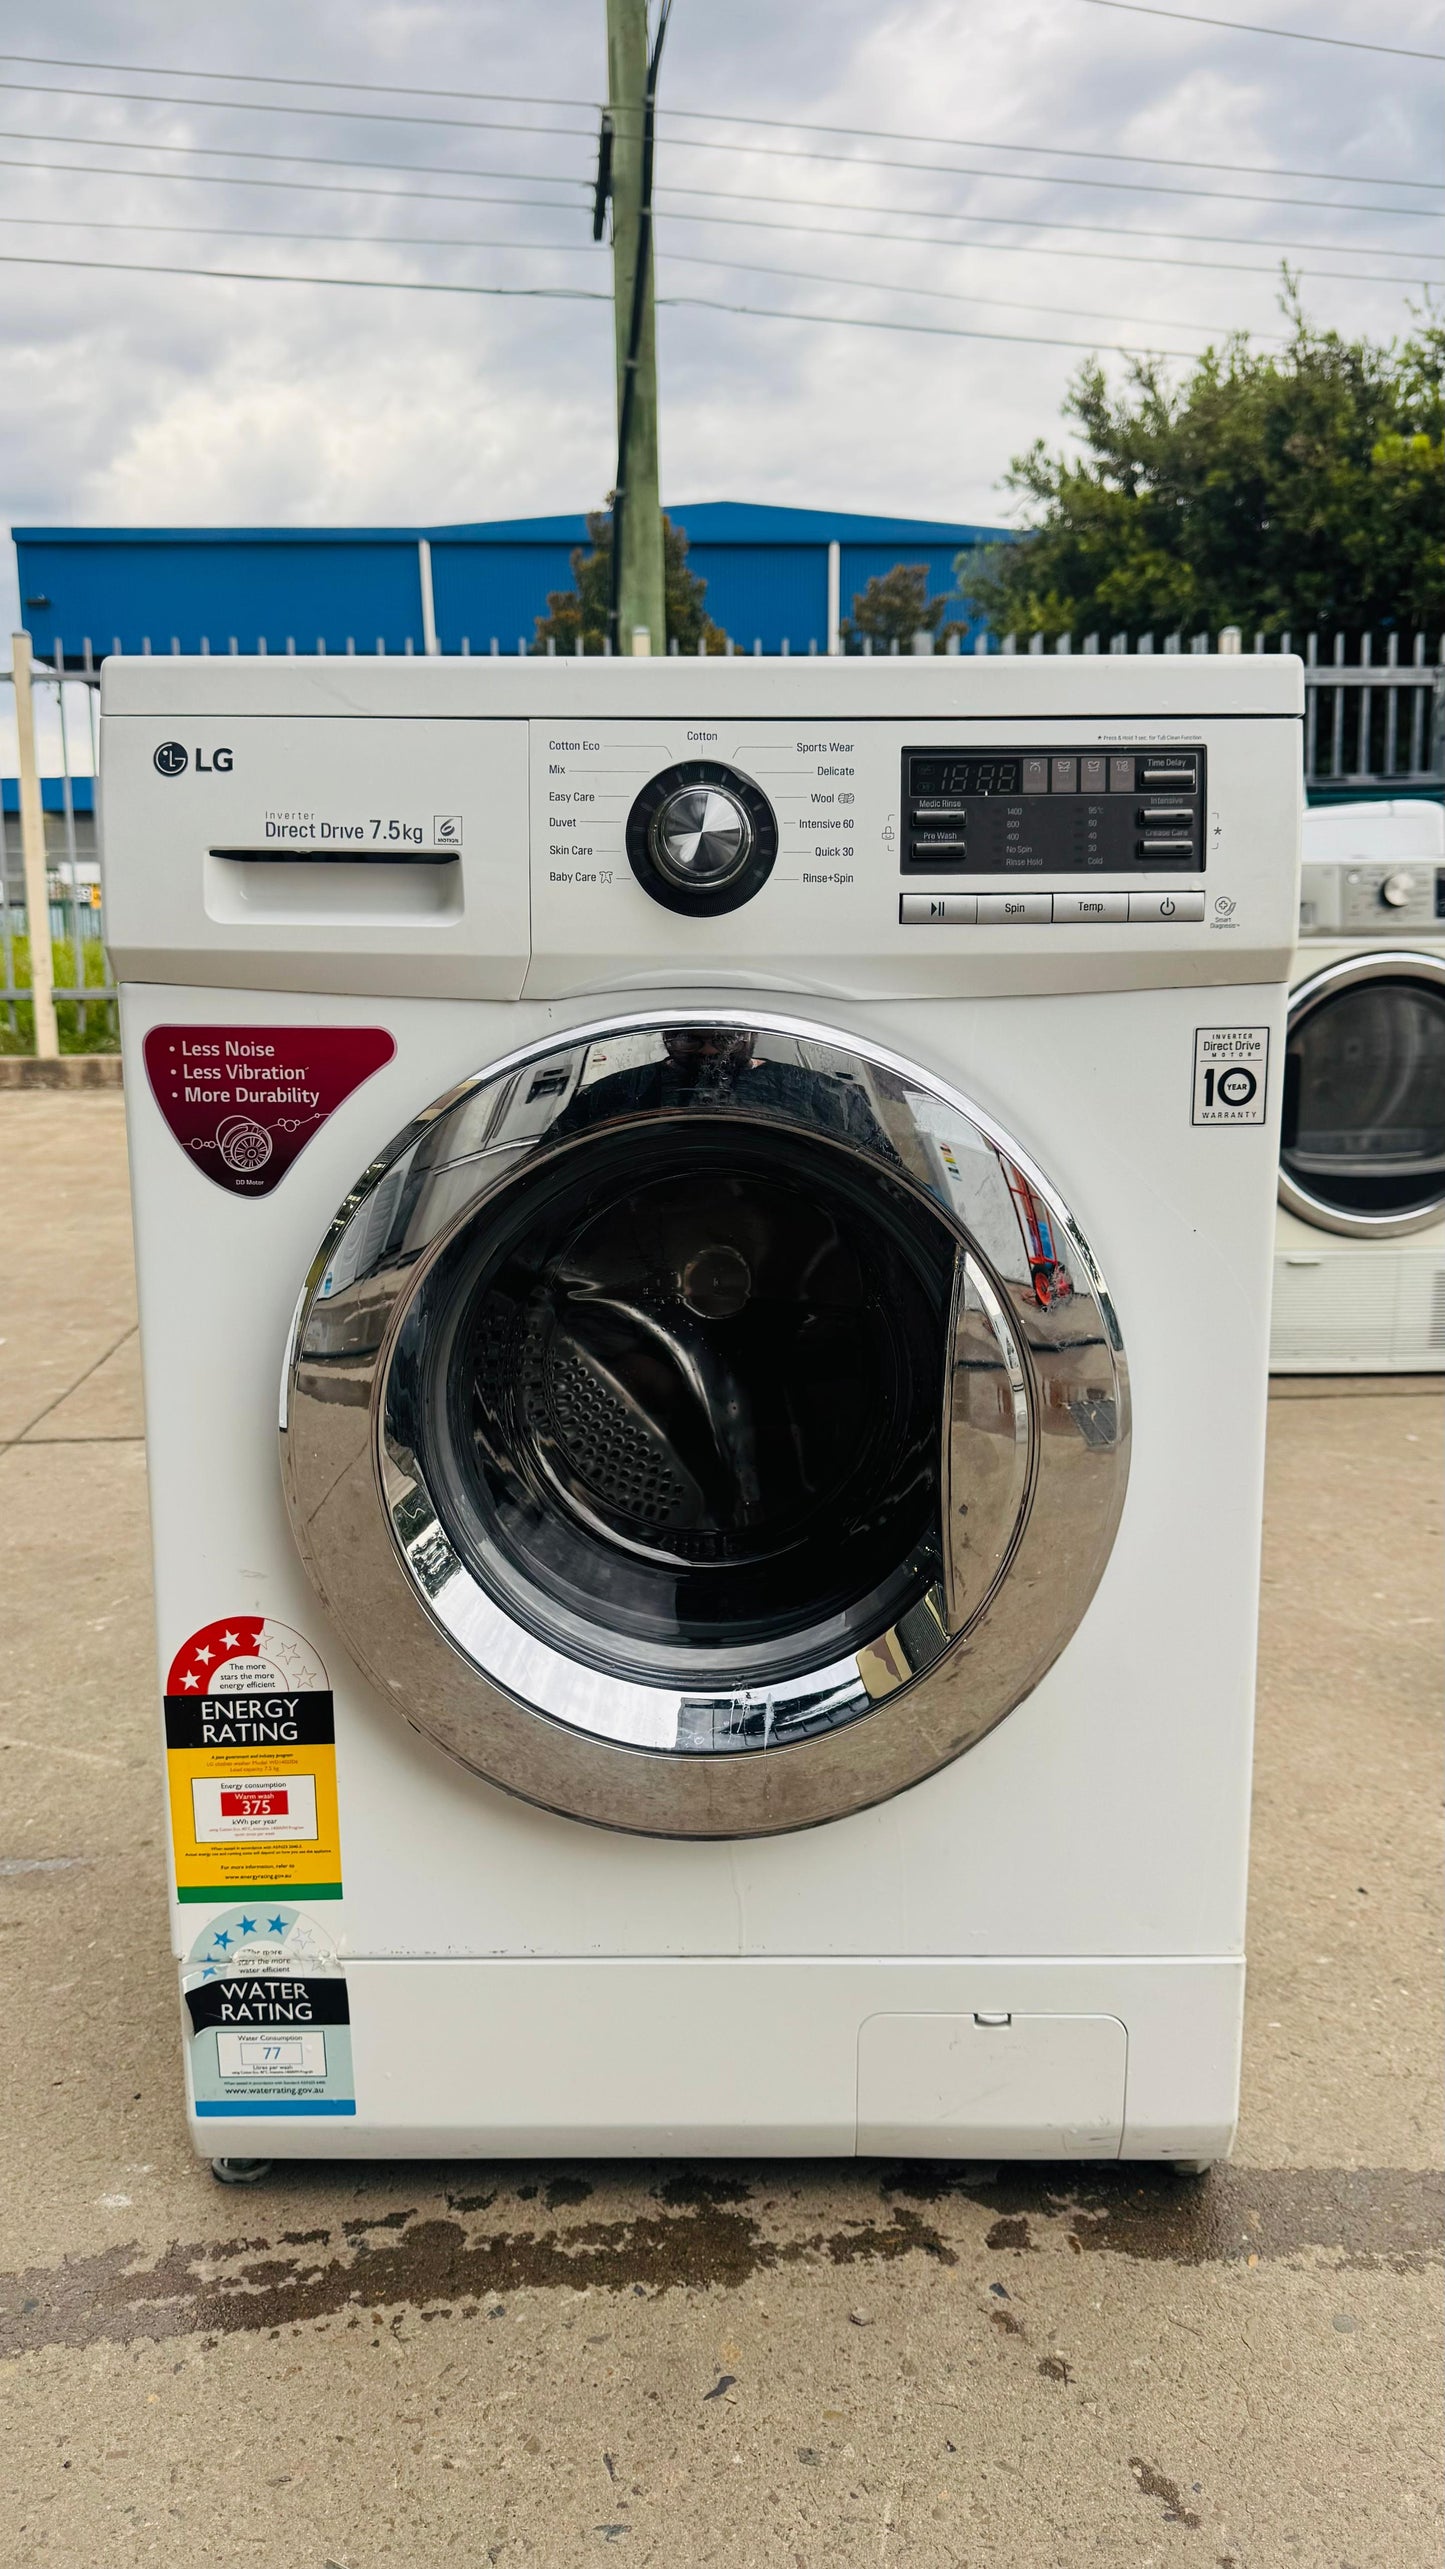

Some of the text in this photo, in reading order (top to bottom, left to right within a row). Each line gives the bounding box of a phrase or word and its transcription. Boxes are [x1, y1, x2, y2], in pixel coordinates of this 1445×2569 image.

[687, 731, 718, 741] Cotton
[549, 741, 600, 750] Cotton Eco
[797, 743, 855, 754] Sports Wear
[196, 748, 233, 772] LG
[1166, 759, 1186, 767] Delay
[549, 765, 566, 775] Mix
[817, 766, 855, 776] Delicate
[549, 792, 595, 804] Easy Care
[811, 793, 834, 803] Wool
[266, 811, 315, 820] Inverter
[549, 818, 576, 827] Duvet
[799, 819, 855, 829] Intensive 60
[266, 820, 423, 844] Direct Drive 7.5kg
[549, 846, 593, 856] Skin Care
[815, 846, 854, 857] Quick 30
[1018, 846, 1032, 854] Spin
[1088, 857, 1103, 865] Cold
[550, 872, 596, 884] Baby Care
[803, 873, 854, 885] Rinse+Spin
[1005, 902, 1025, 915] Spin
[1078, 901, 1105, 913] Temp.
[182, 1040, 274, 1057] Less Noise
[1204, 1041, 1260, 1051] Direct Drive
[184, 1064, 305, 1080] Less Vibration
[1204, 1067, 1256, 1106] 10
[185, 1087, 320, 1107] More Durability
[201, 1699, 299, 1721] ENERGY
[203, 1722, 298, 1743] RATING
[242, 1800, 271, 1815] 375
[221, 1982, 309, 1999] WATER
[222, 2003, 313, 2021] RATING
[263, 2047, 281, 2059] 77
